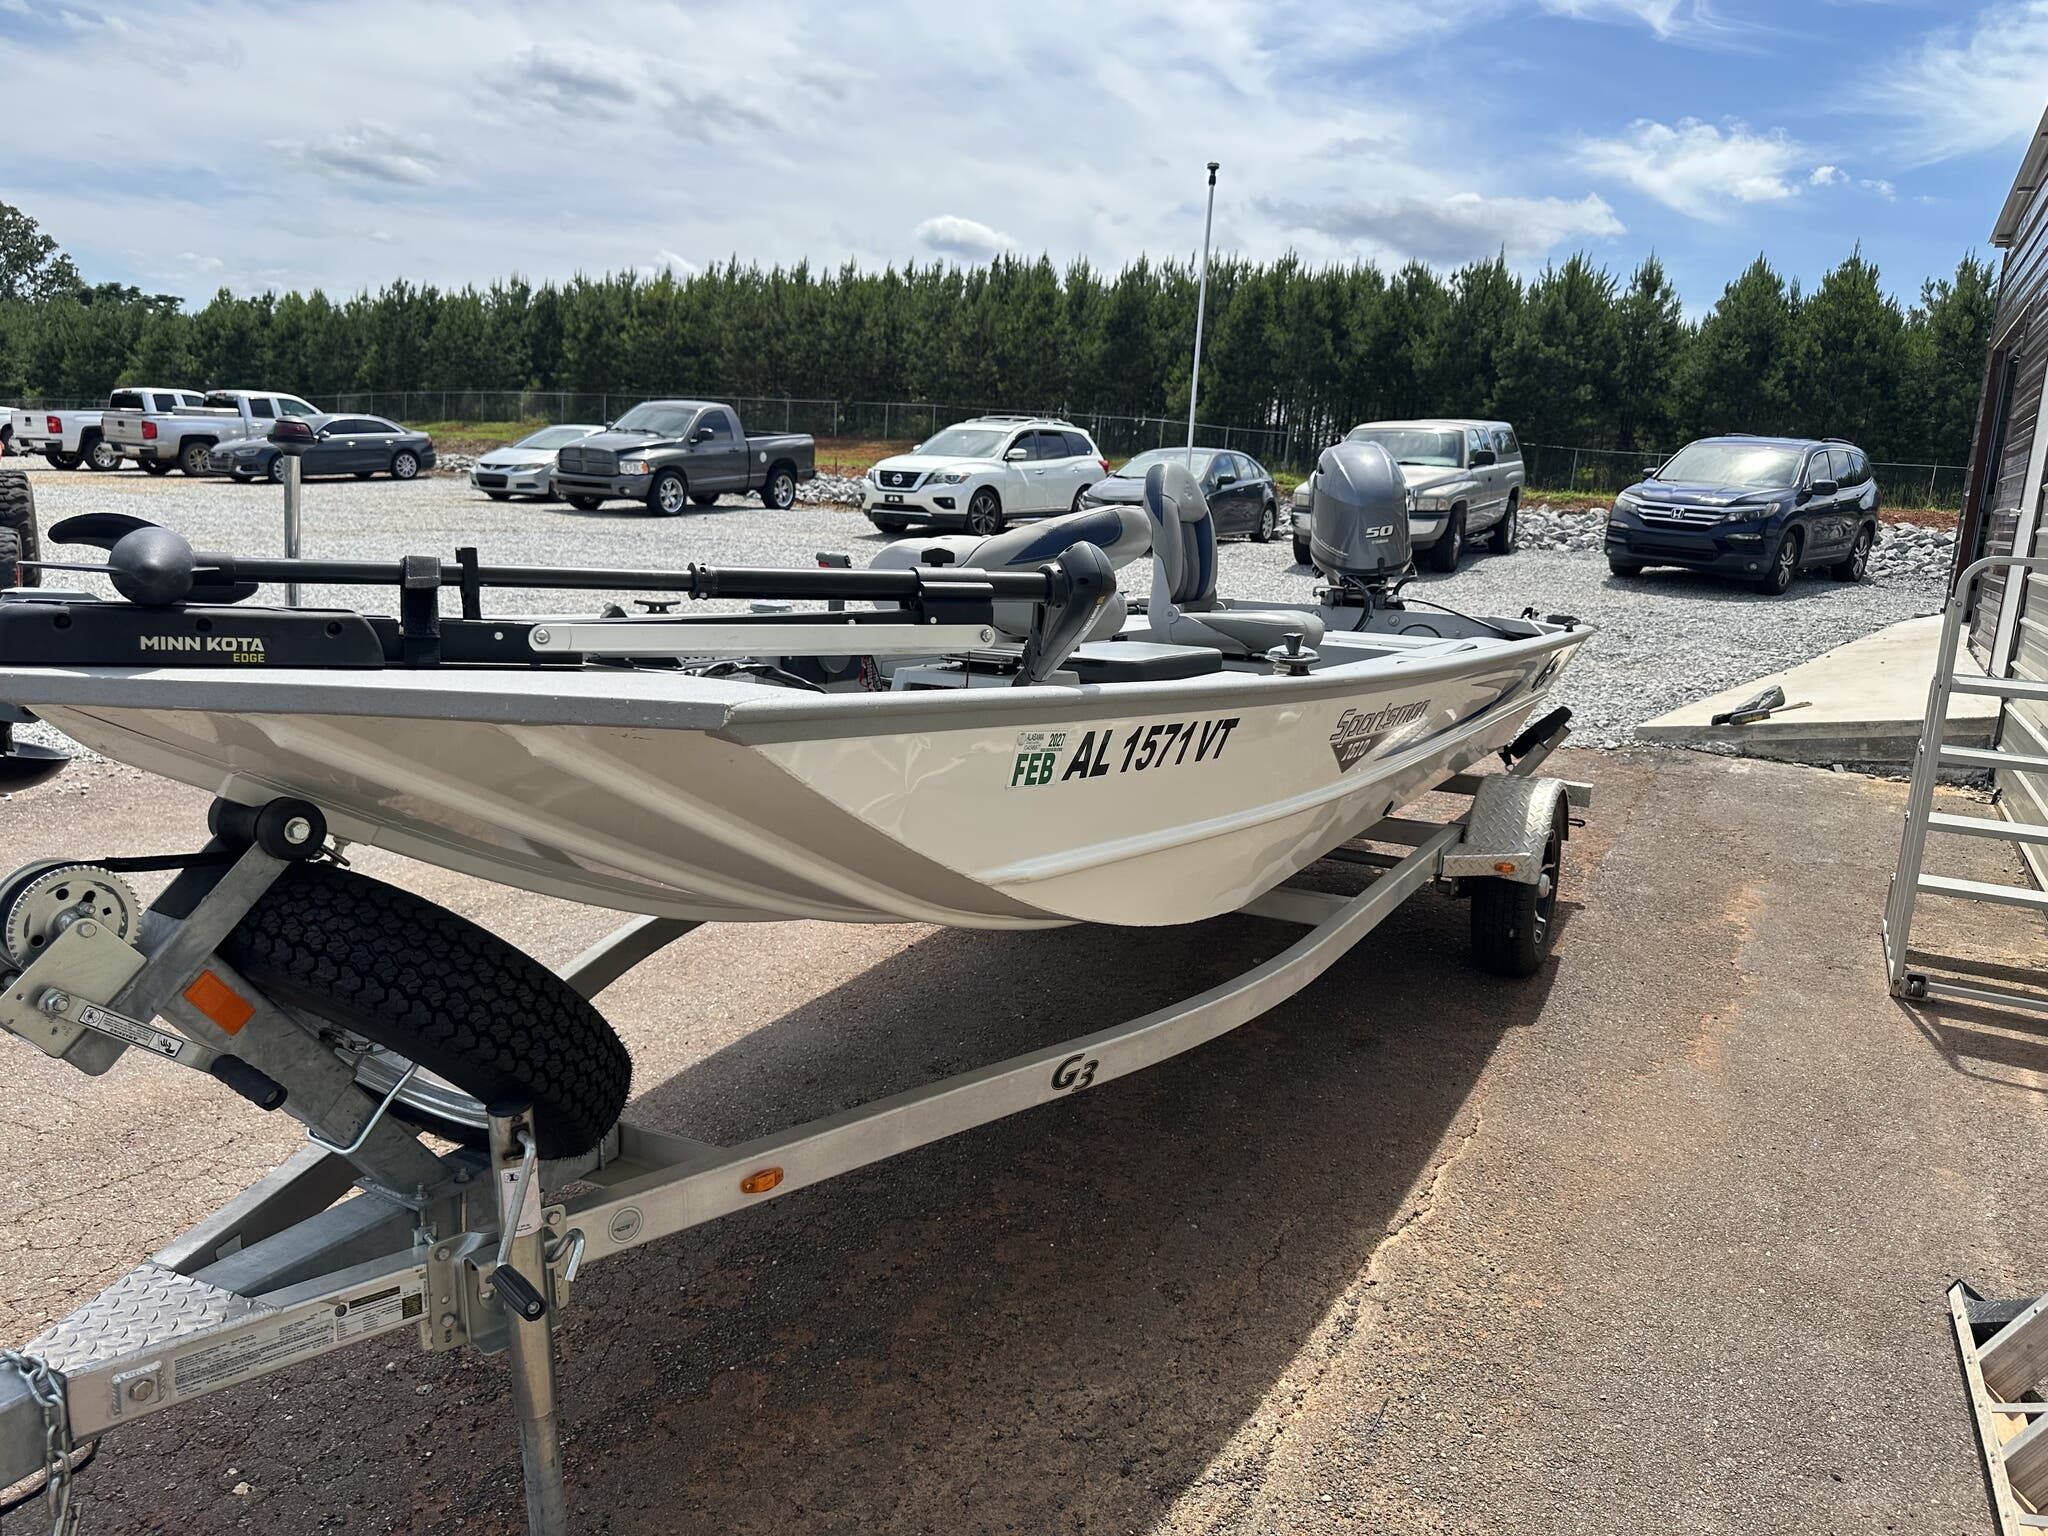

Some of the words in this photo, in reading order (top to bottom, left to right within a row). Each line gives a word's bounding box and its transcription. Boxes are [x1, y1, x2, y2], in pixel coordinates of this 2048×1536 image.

[1365, 525, 1394, 538] 50
[140, 636, 200, 651] MINN
[207, 637, 265, 652] KOTA
[233, 653, 265, 663] EDGE
[1329, 699, 1431, 746] Sportsman
[1048, 732, 1066, 747] 2027
[1061, 729, 1113, 781] AL
[1011, 752, 1056, 786] FEB
[1051, 1053, 1099, 1092] G3
